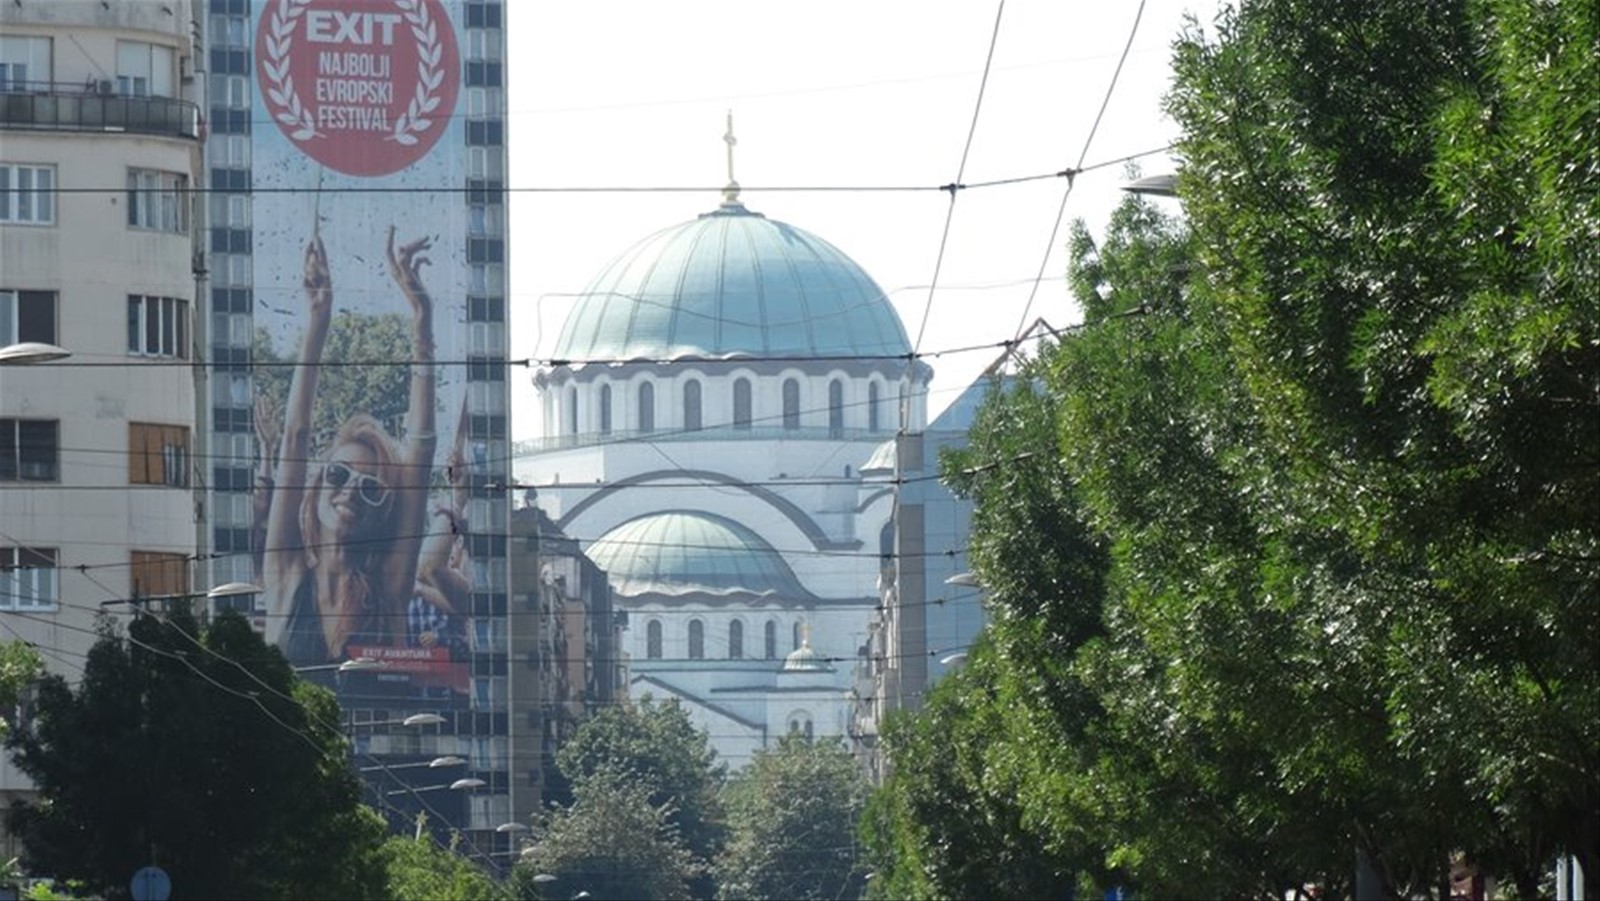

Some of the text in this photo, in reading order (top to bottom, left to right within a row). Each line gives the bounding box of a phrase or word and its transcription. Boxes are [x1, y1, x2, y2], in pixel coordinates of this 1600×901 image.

[306, 10, 402, 45] EXIT
[319, 52, 390, 78] NAJBOLJI
[316, 78, 393, 104] EVROPSKI
[318, 105, 392, 131] FESTIVAL
[362, 648, 432, 659] EXIT AVANTURA
